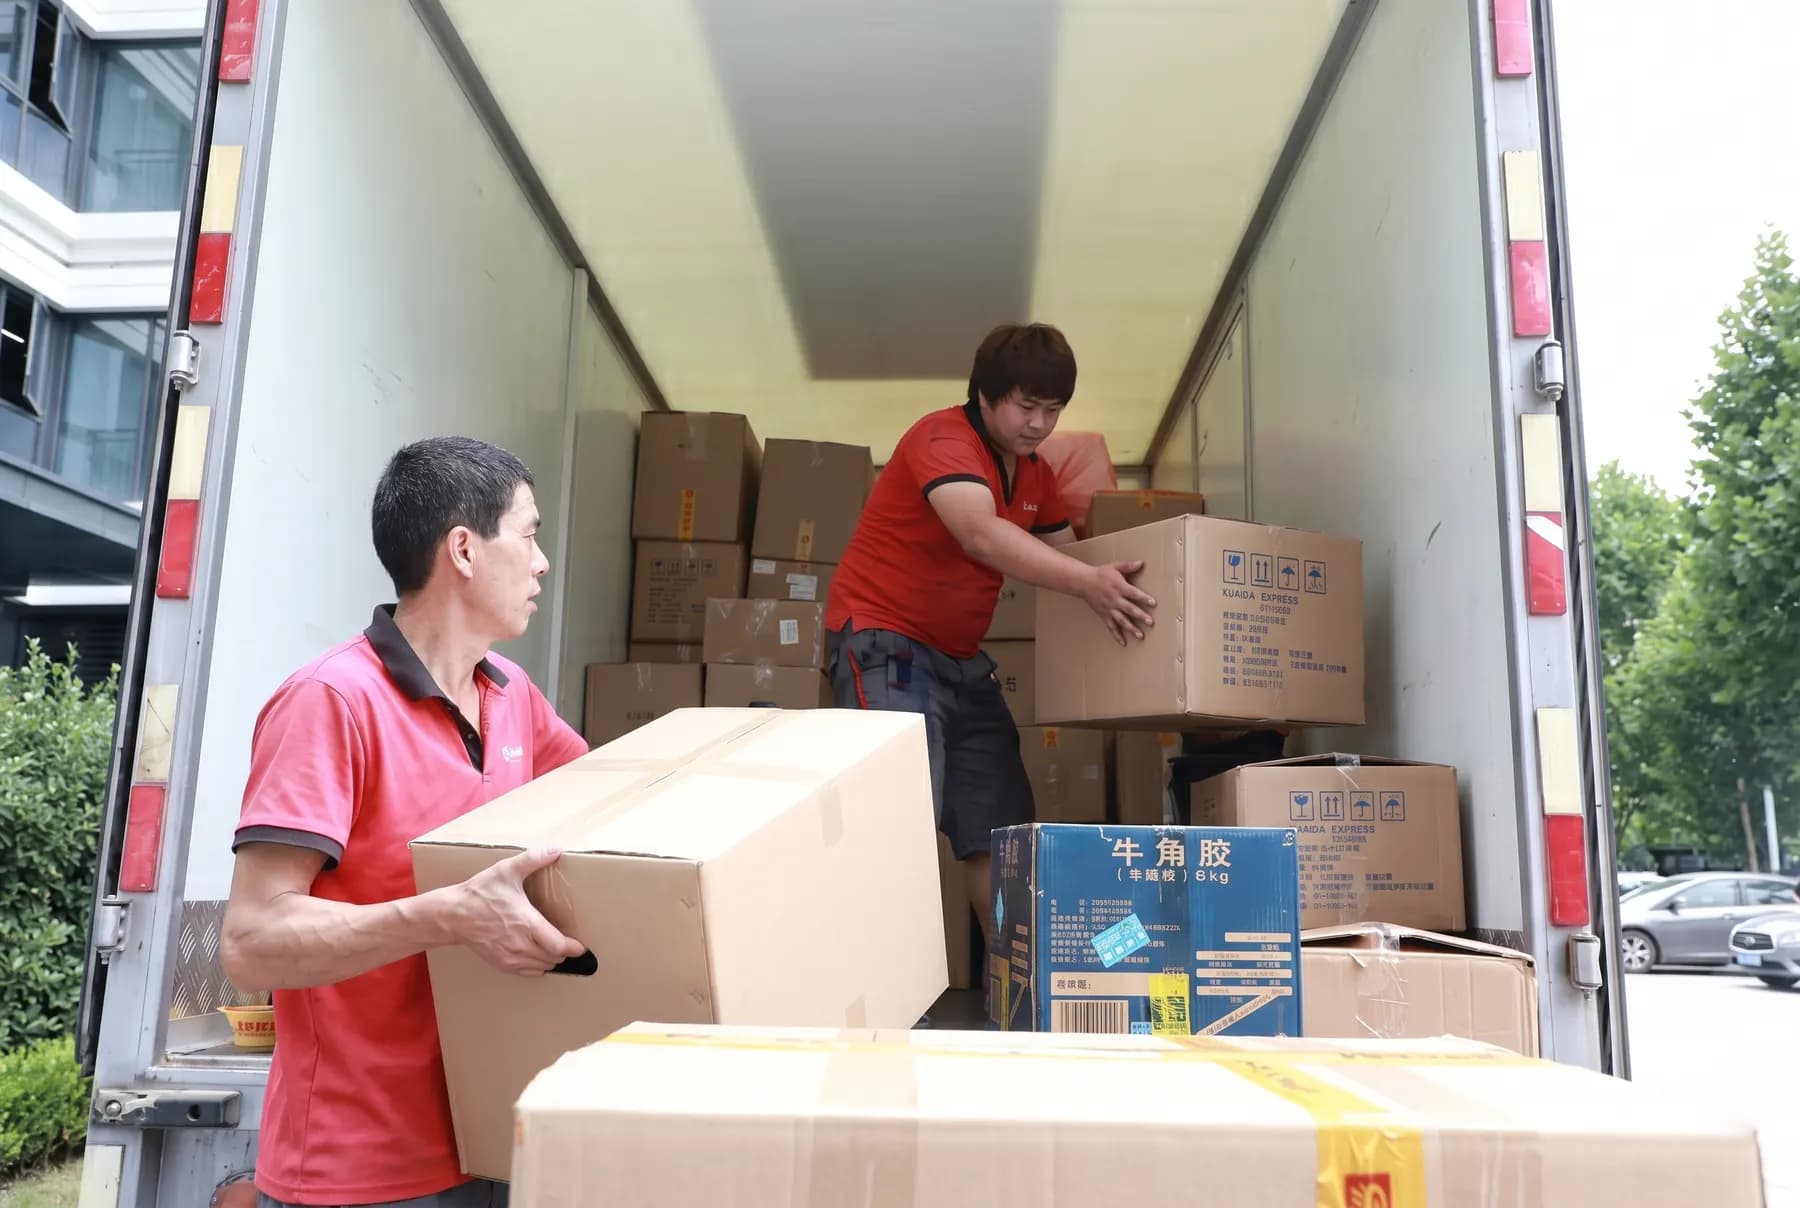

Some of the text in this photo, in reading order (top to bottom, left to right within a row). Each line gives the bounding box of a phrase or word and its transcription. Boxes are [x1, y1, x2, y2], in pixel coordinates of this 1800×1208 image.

[1222, 588, 1299, 605] KUAIDA EXPRESS
[1332, 825, 1376, 834] EXPRESS
[1111, 837, 1232, 868] 牛角胶
[1195, 870, 1229, 885] 8kg
